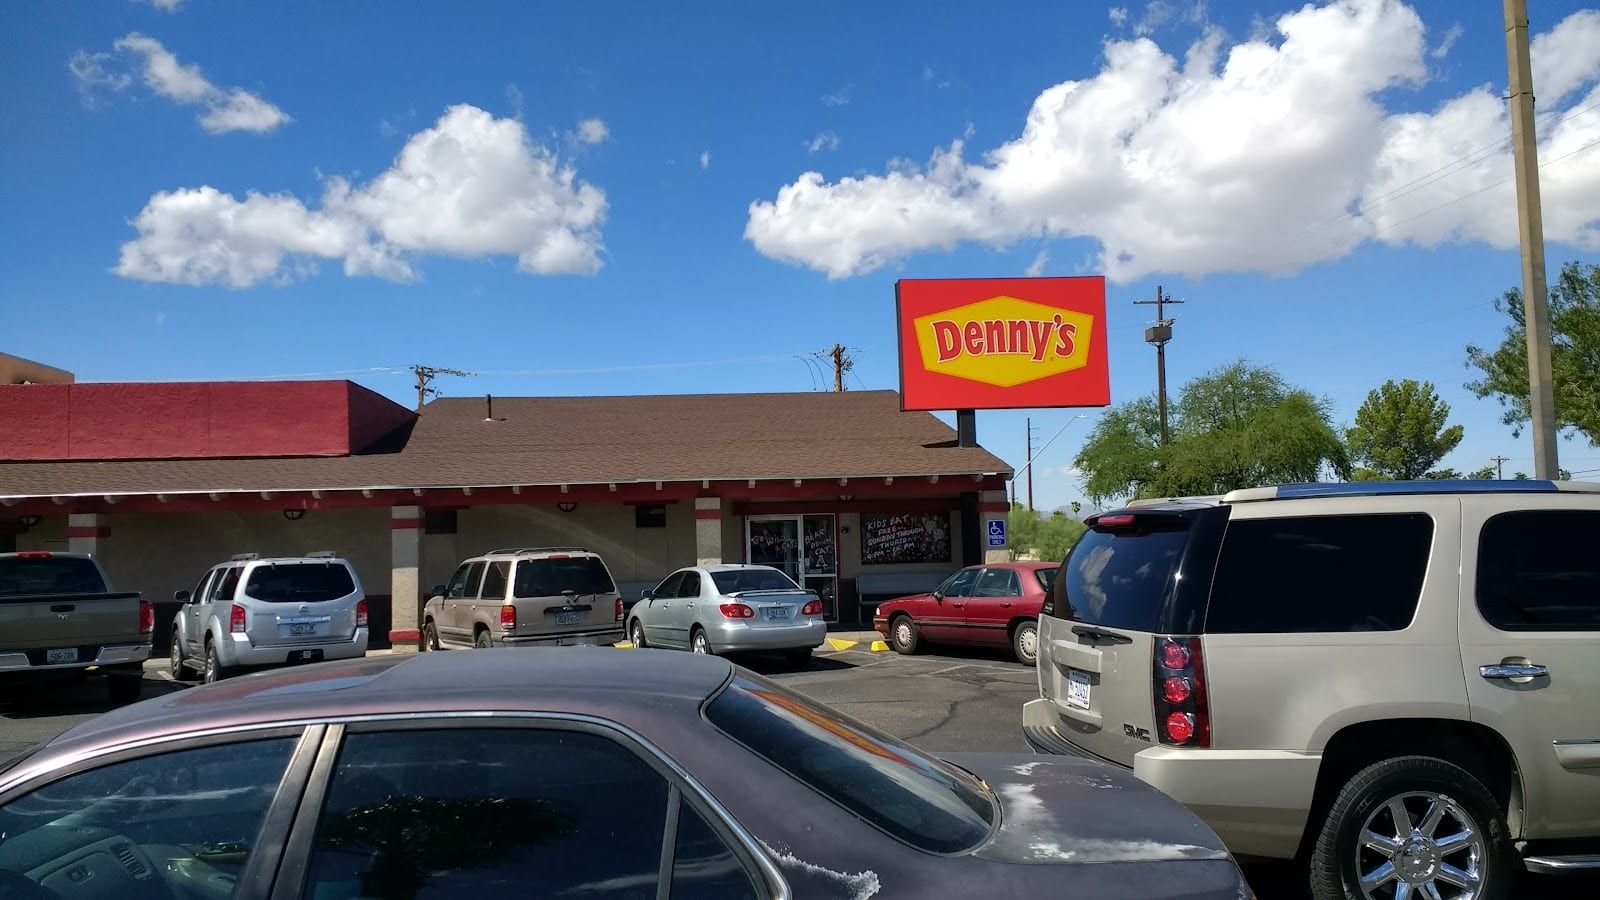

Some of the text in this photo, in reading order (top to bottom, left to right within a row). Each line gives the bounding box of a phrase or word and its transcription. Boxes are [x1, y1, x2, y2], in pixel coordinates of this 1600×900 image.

[931, 313, 1077, 363] Denny's
[889, 513, 909, 525] EAT
[868, 533, 896, 546] SUNDAY
[1123, 723, 1151, 742] GMC
